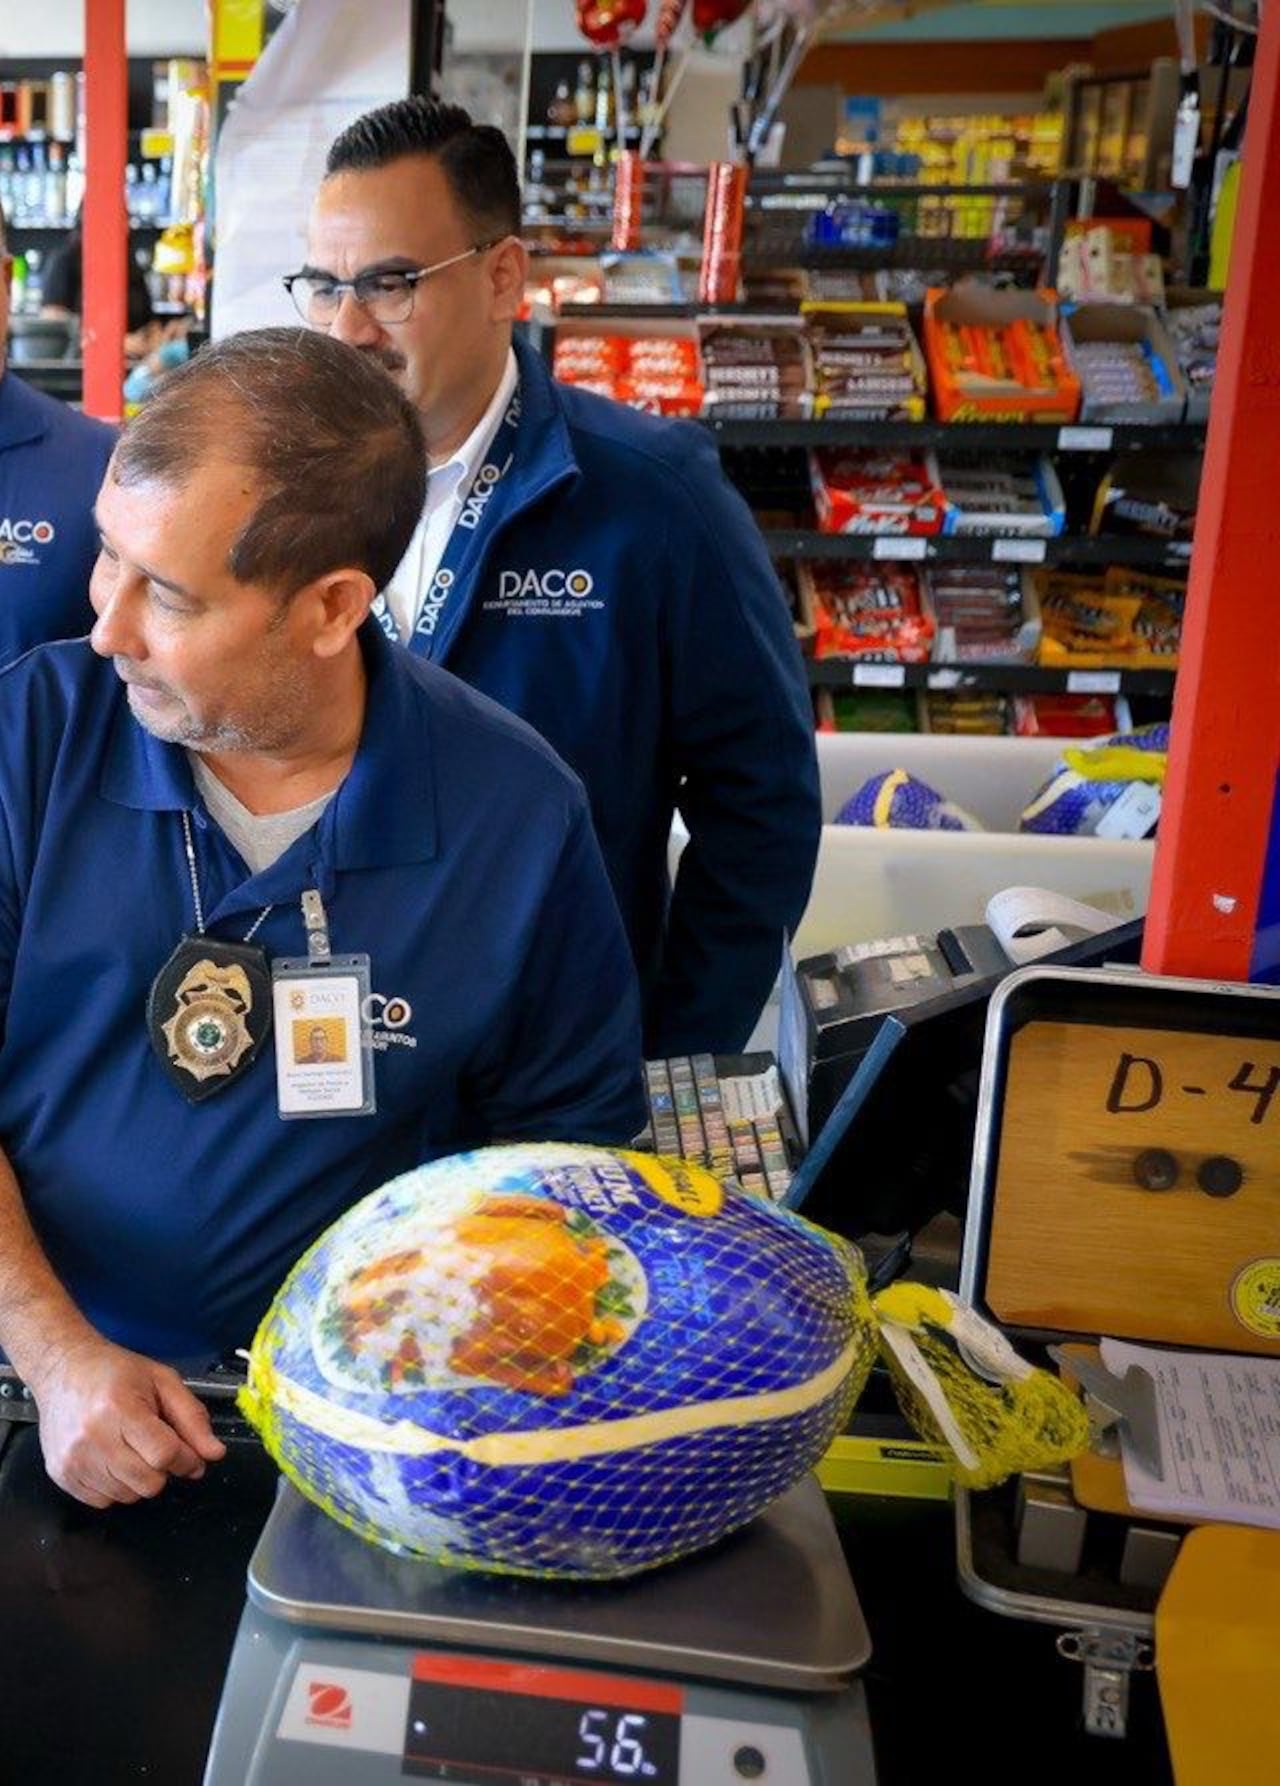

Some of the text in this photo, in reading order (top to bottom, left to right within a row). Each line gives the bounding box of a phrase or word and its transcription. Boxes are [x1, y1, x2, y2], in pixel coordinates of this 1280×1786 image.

[459, 464, 501, 530] DACO
[416, 567, 455, 635] DACO
[498, 568, 594, 600] DACO
[360, 992, 412, 1029] CO
